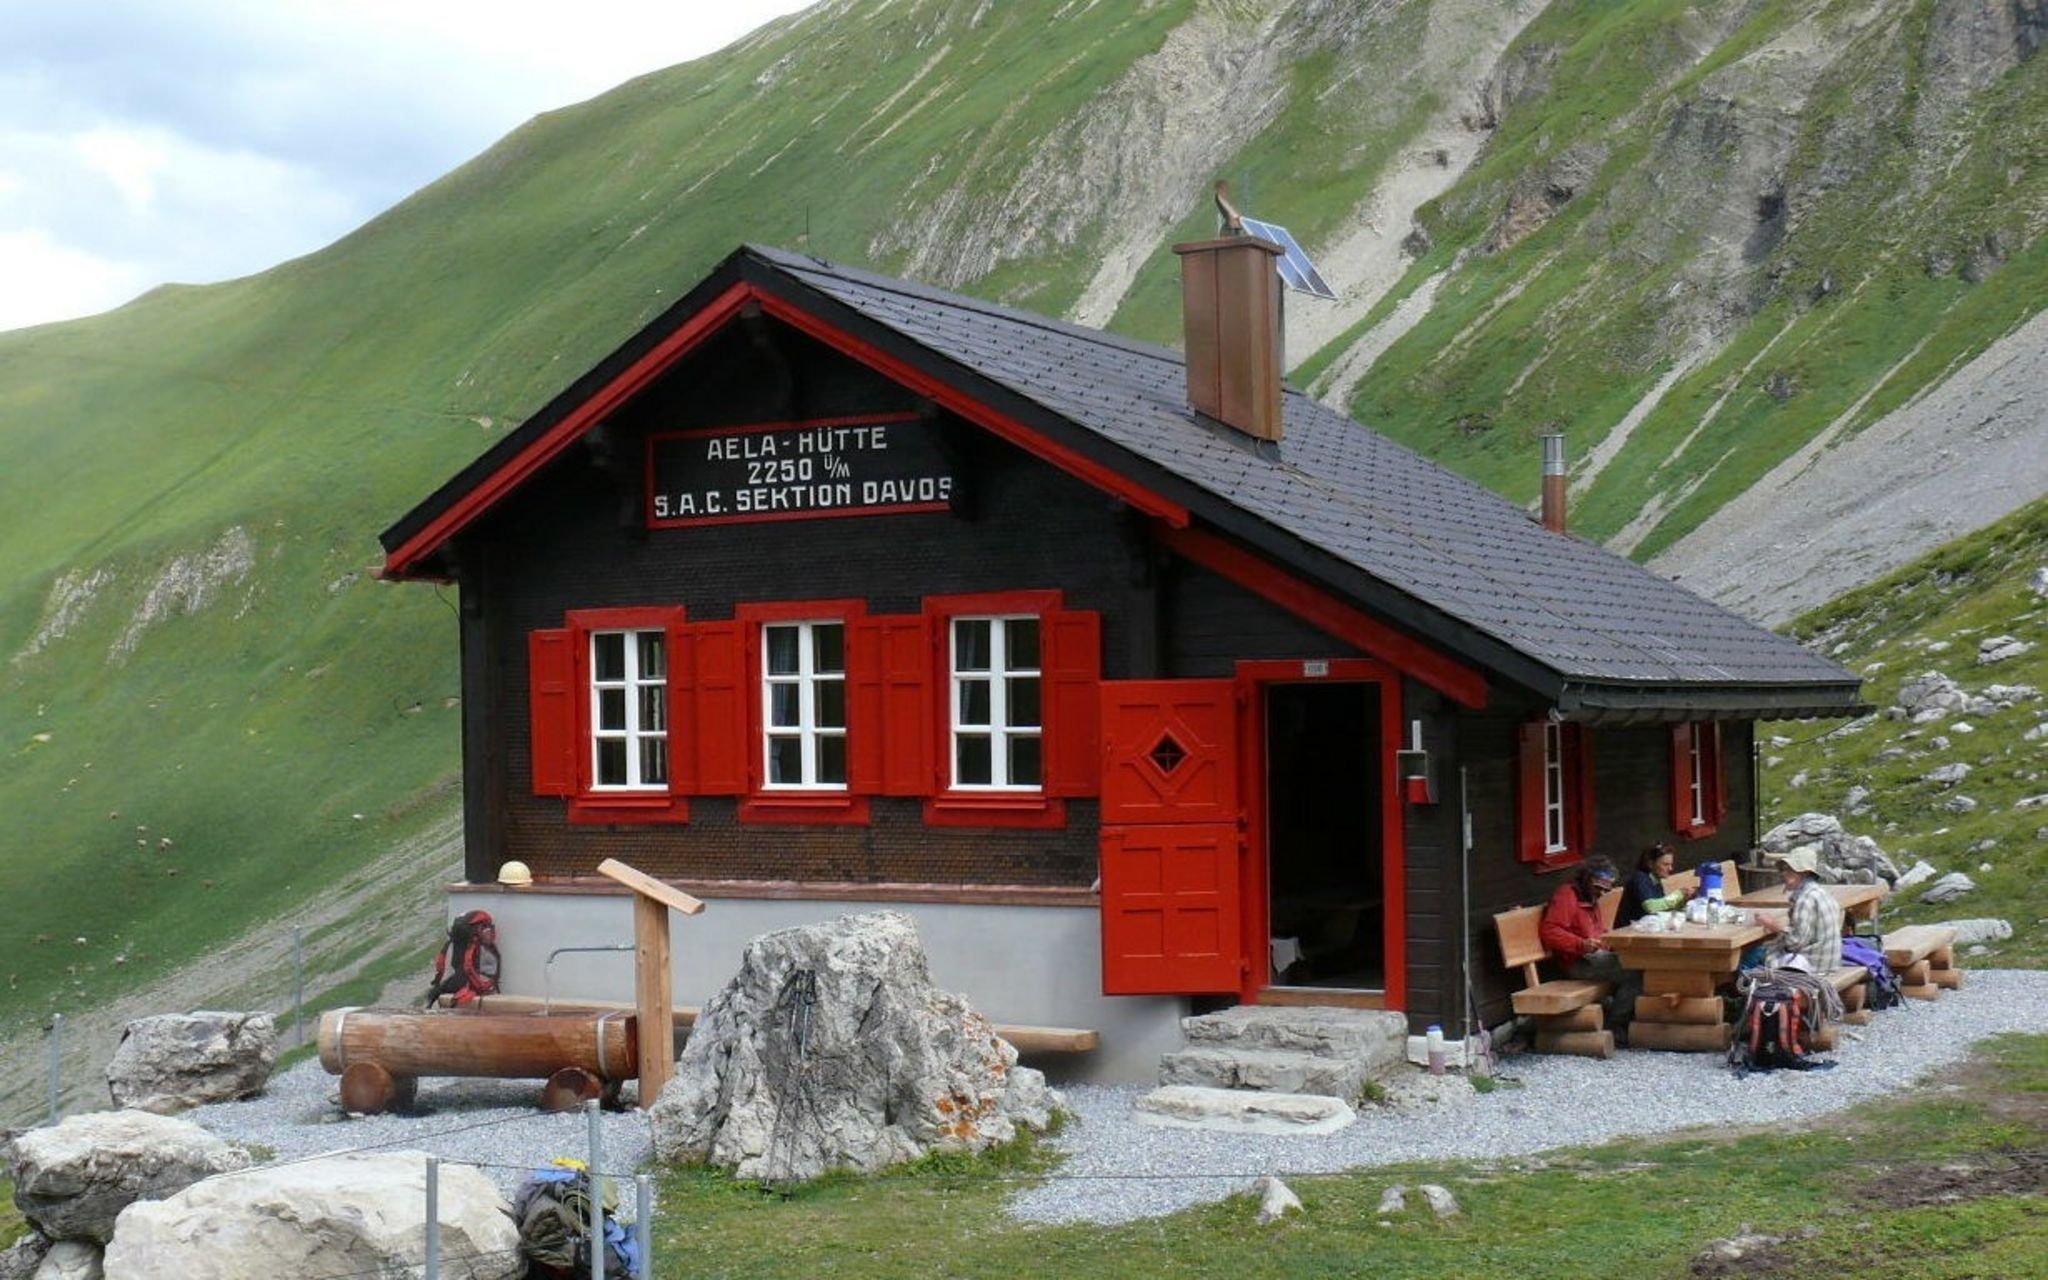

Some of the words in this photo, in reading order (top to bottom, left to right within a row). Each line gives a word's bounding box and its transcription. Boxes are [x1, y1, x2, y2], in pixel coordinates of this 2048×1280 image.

[748, 458, 813, 485] 2250
[654, 491, 728, 517] S.A.C.
[735, 483, 851, 512] SEKTION
[862, 476, 953, 504] DAVOS
